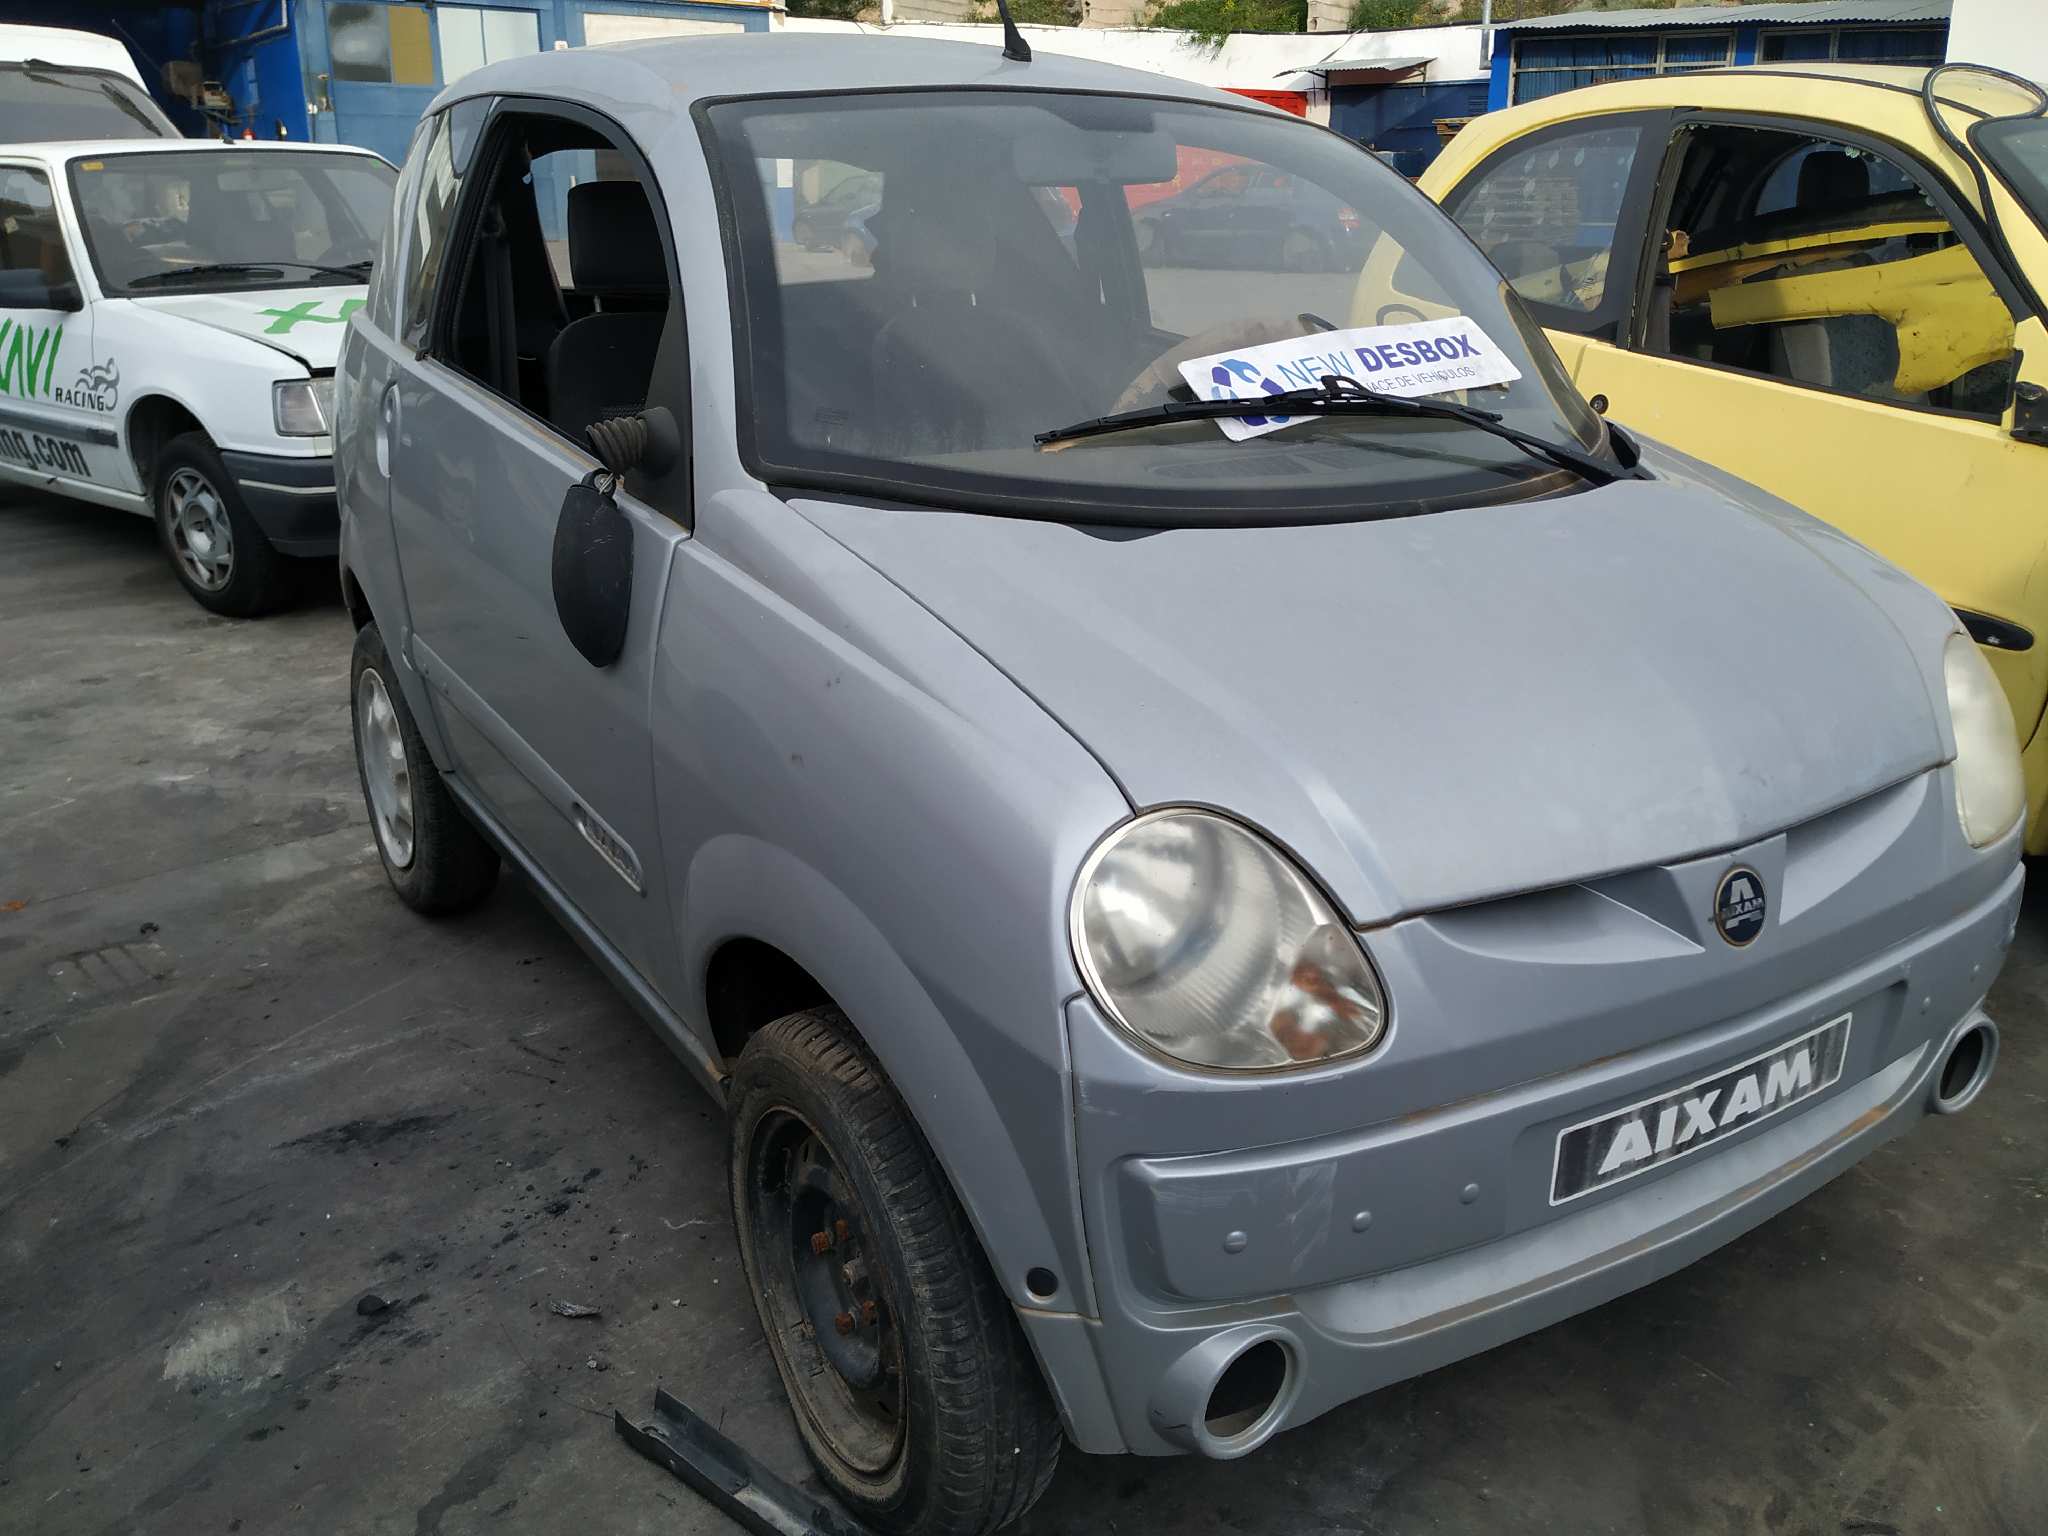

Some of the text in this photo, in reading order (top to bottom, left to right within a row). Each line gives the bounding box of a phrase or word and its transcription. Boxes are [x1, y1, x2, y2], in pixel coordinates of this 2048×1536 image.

[1276, 333, 1482, 389] NEW DESBOX
[1395, 375, 1416, 388] DE
[55, 386, 104, 412] RACING
[1597, 1048, 1812, 1176] AIXAM
